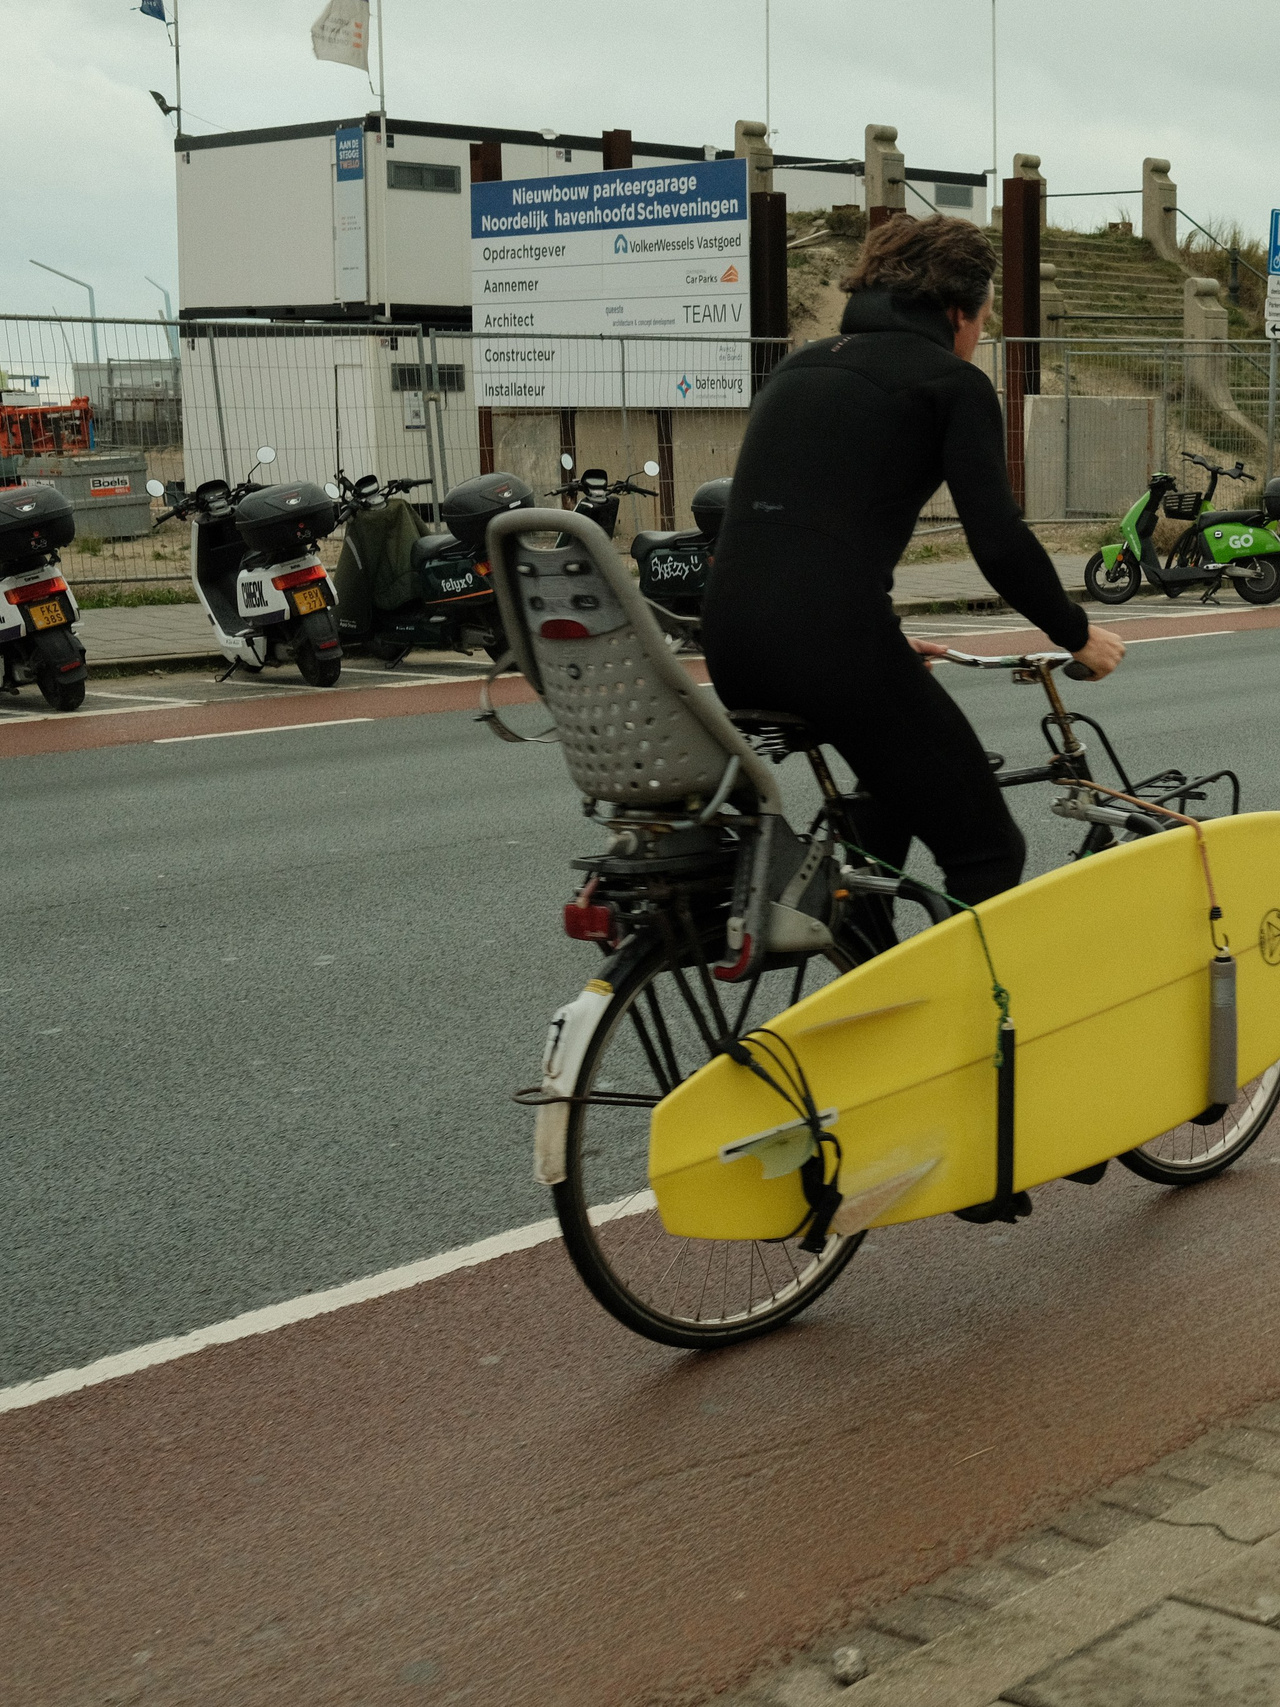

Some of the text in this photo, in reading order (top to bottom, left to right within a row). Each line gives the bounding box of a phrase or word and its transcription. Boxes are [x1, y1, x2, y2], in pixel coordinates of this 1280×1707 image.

[339, 139, 359, 150] AAN DE
[339, 149, 359, 160] STEGGE
[512, 176, 697, 205] Nieuwbouw parkeergarage
[481, 197, 739, 231] Noordelijk havenhoofd Scheveningen
[629, 233, 742, 253] VolkerWessels Vastgoed
[483, 244, 566, 263] Opdrachtgever
[483, 279, 539, 293] Aannemer
[685, 275, 718, 284] Car Parks
[484, 313, 535, 328] Architect
[682, 304, 727, 323] TEAM
[731, 303, 742, 322] V
[484, 348, 555, 362] Constructeur
[485, 382, 546, 397] Installateur
[695, 375, 743, 394] batenburg
[91, 477, 128, 488] Boels
[1229, 533, 1254, 548] GO
[441, 577, 467, 592] felyx
[40, 603, 60, 616] FKZ
[44, 613, 63, 625] 38S
